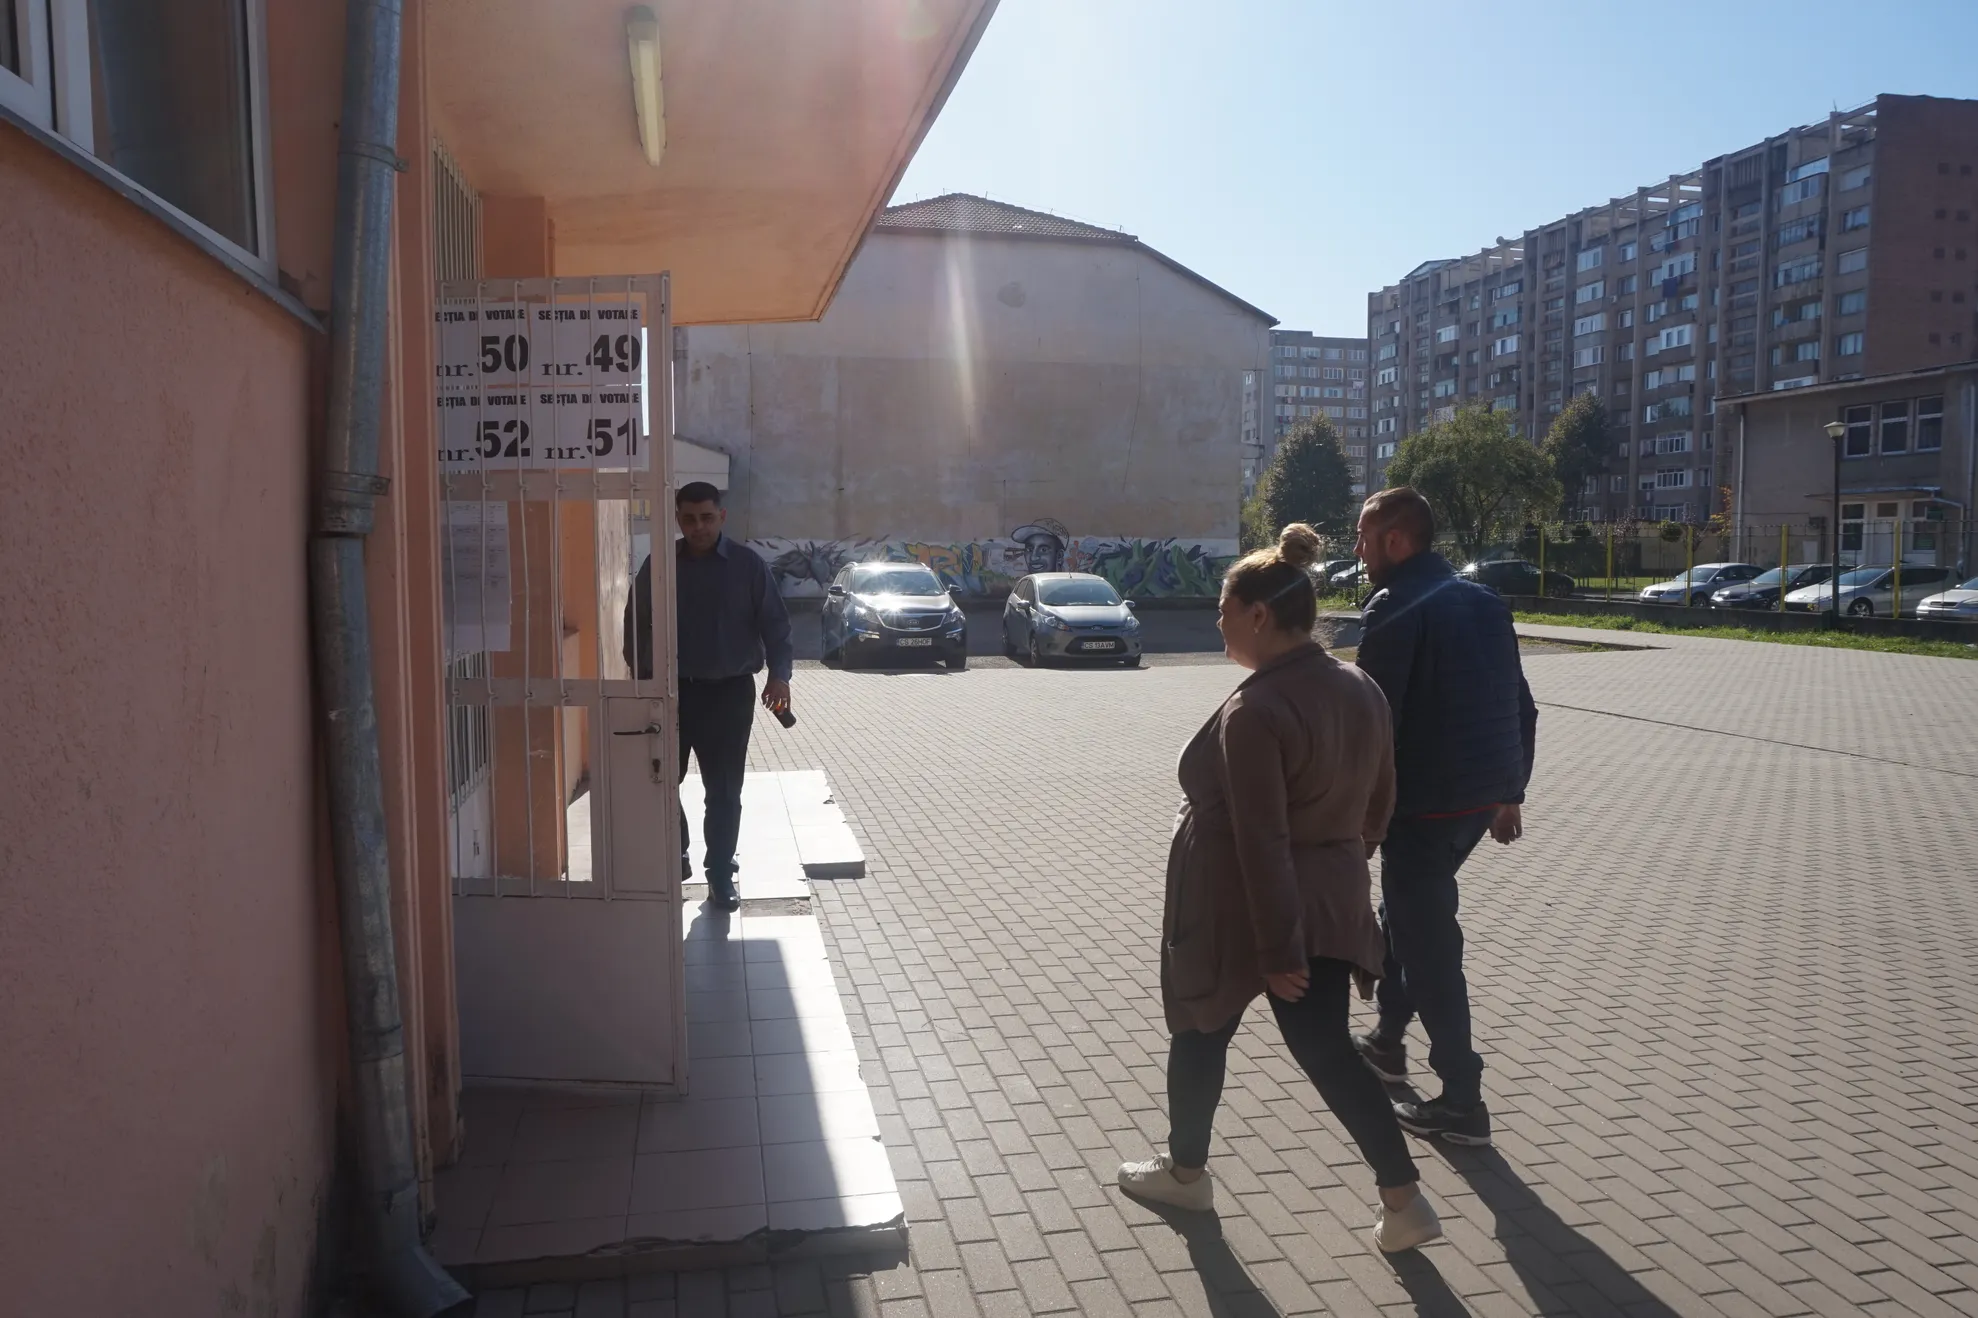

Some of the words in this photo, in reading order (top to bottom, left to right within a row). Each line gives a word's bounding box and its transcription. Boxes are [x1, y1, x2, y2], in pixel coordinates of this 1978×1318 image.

[436, 364, 474, 377] nr.
[477, 334, 529, 374] 50
[541, 363, 583, 376] nr.
[585, 334, 641, 373] 49
[438, 448, 475, 462] nr.
[475, 419, 531, 459] 52
[544, 446, 586, 460] nr.
[586, 417, 637, 457] 51
